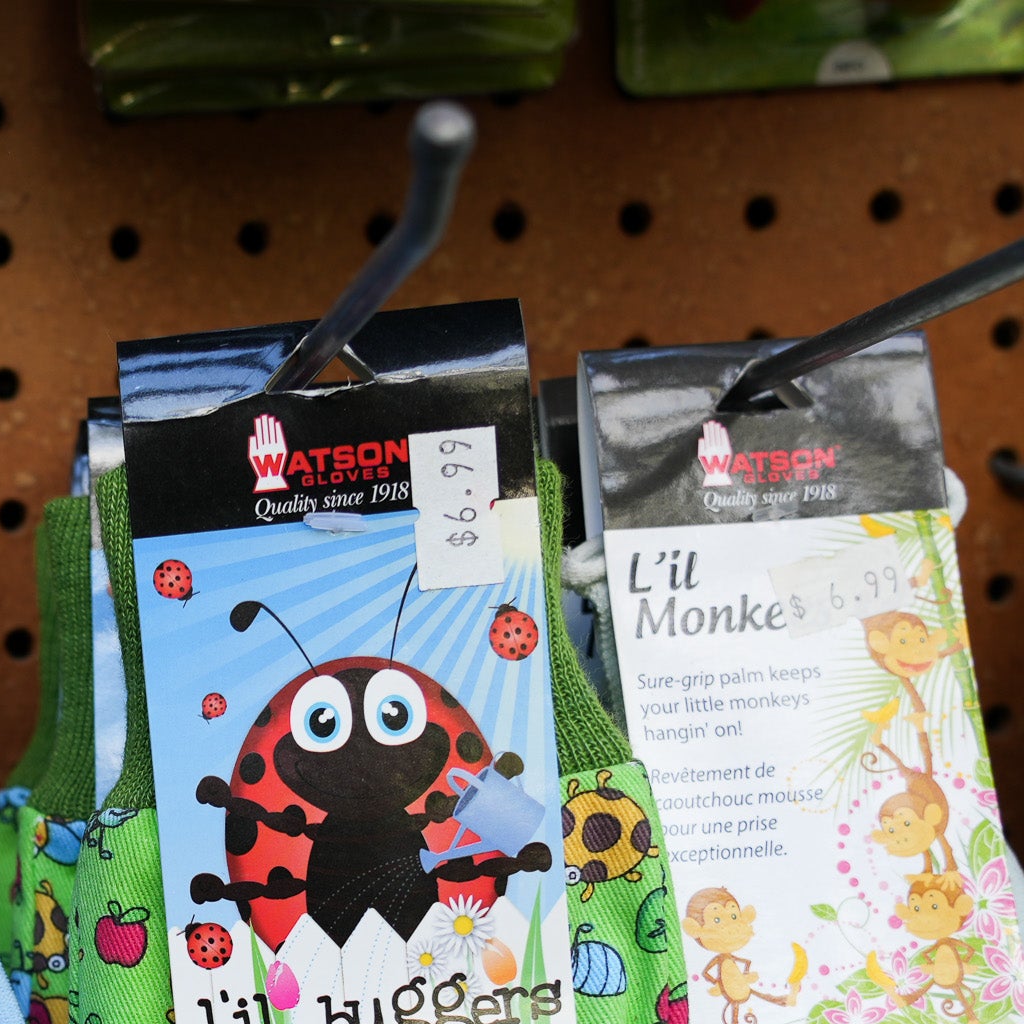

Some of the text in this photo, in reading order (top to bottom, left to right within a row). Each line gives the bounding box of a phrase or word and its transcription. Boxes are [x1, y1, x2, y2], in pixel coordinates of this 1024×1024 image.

[253, 438, 409, 477] WATSON
[700, 447, 836, 475] WATSON
[301, 466, 391, 486] GLOVES
[744, 470, 820, 484] GLOVES
[254, 481, 410, 522] Quality since 1918
[439, 439, 479, 547] $6.99
[704, 484, 838, 513] Quality since 1918
[635, 594, 787, 639] Monke
[637, 665, 822, 691] Sure-grip palm keeps
[640, 691, 810, 719] your little monkeys
[644, 721, 743, 743] hangin' on!
[651, 762, 776, 785] Revêtement de
[657, 788, 824, 812] caoutchouc mousse
[701, 820, 733, 835] une
[738, 815, 777, 836] prise
[667, 839, 788, 866] xceptionnelle.
